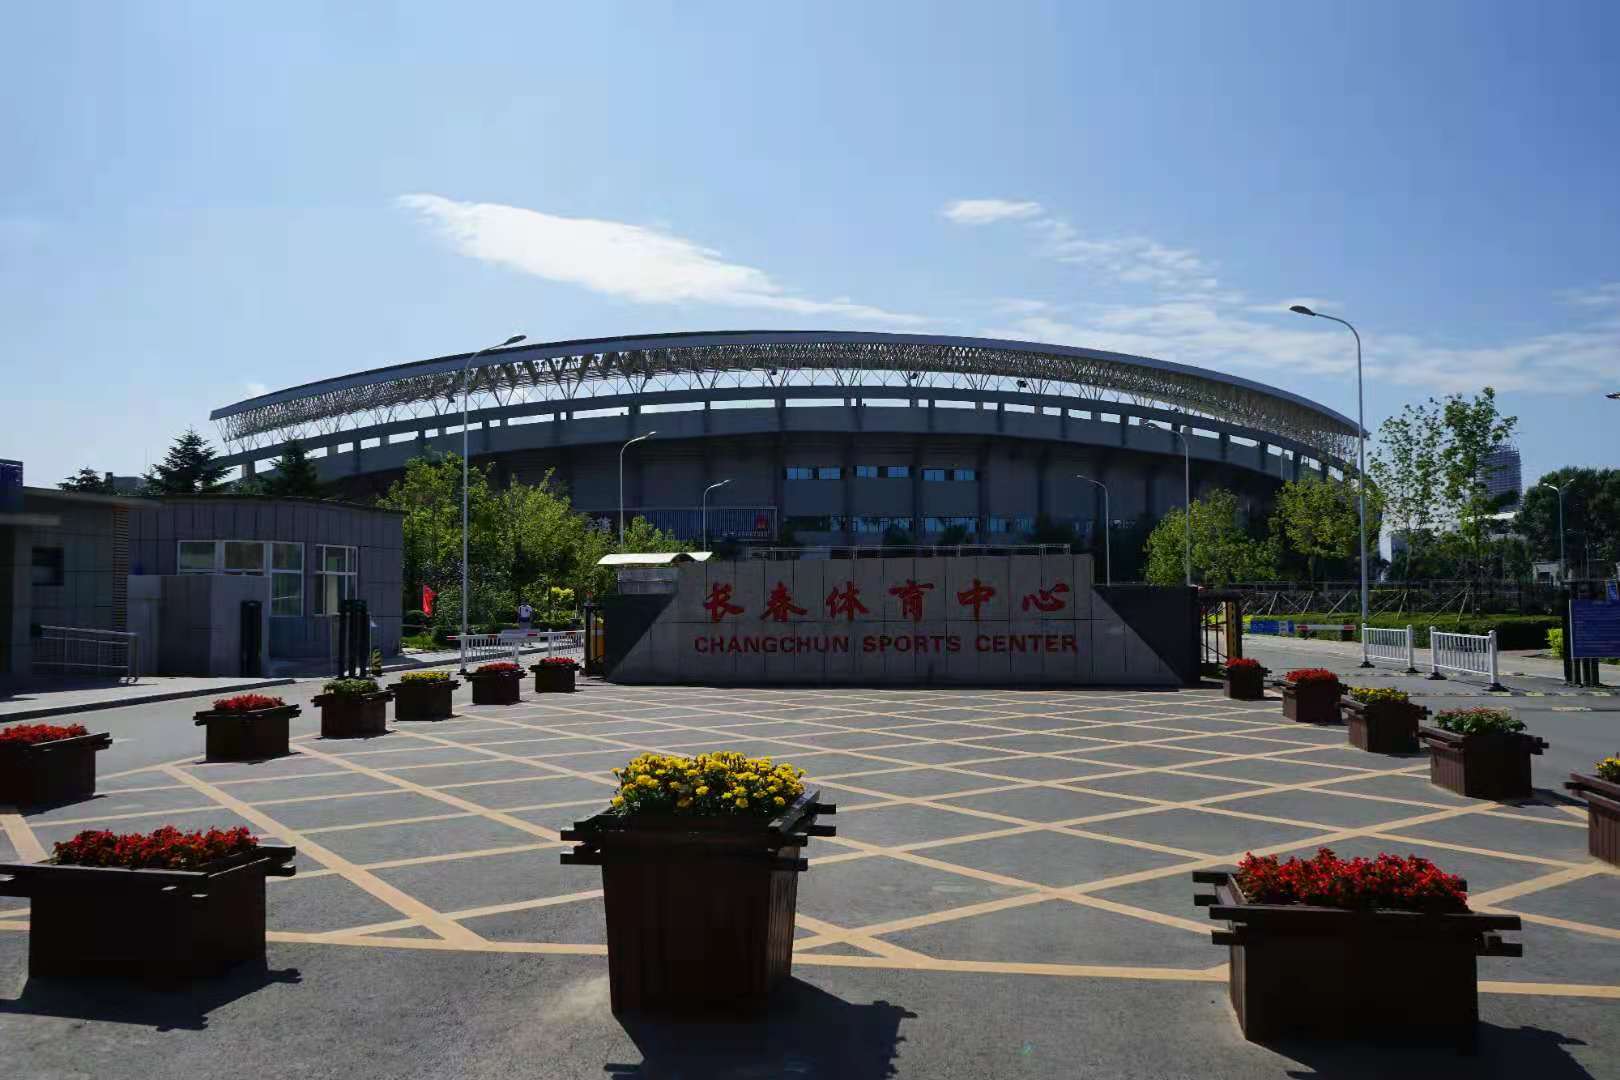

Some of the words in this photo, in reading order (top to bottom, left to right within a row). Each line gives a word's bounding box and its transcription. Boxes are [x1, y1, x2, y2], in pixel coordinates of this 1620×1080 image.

[704, 579, 1071, 622] 长春体育中心
[694, 635, 849, 654] CHANGCHUN
[863, 635, 961, 653] SPORTS
[975, 635, 1078, 653] CENTER
